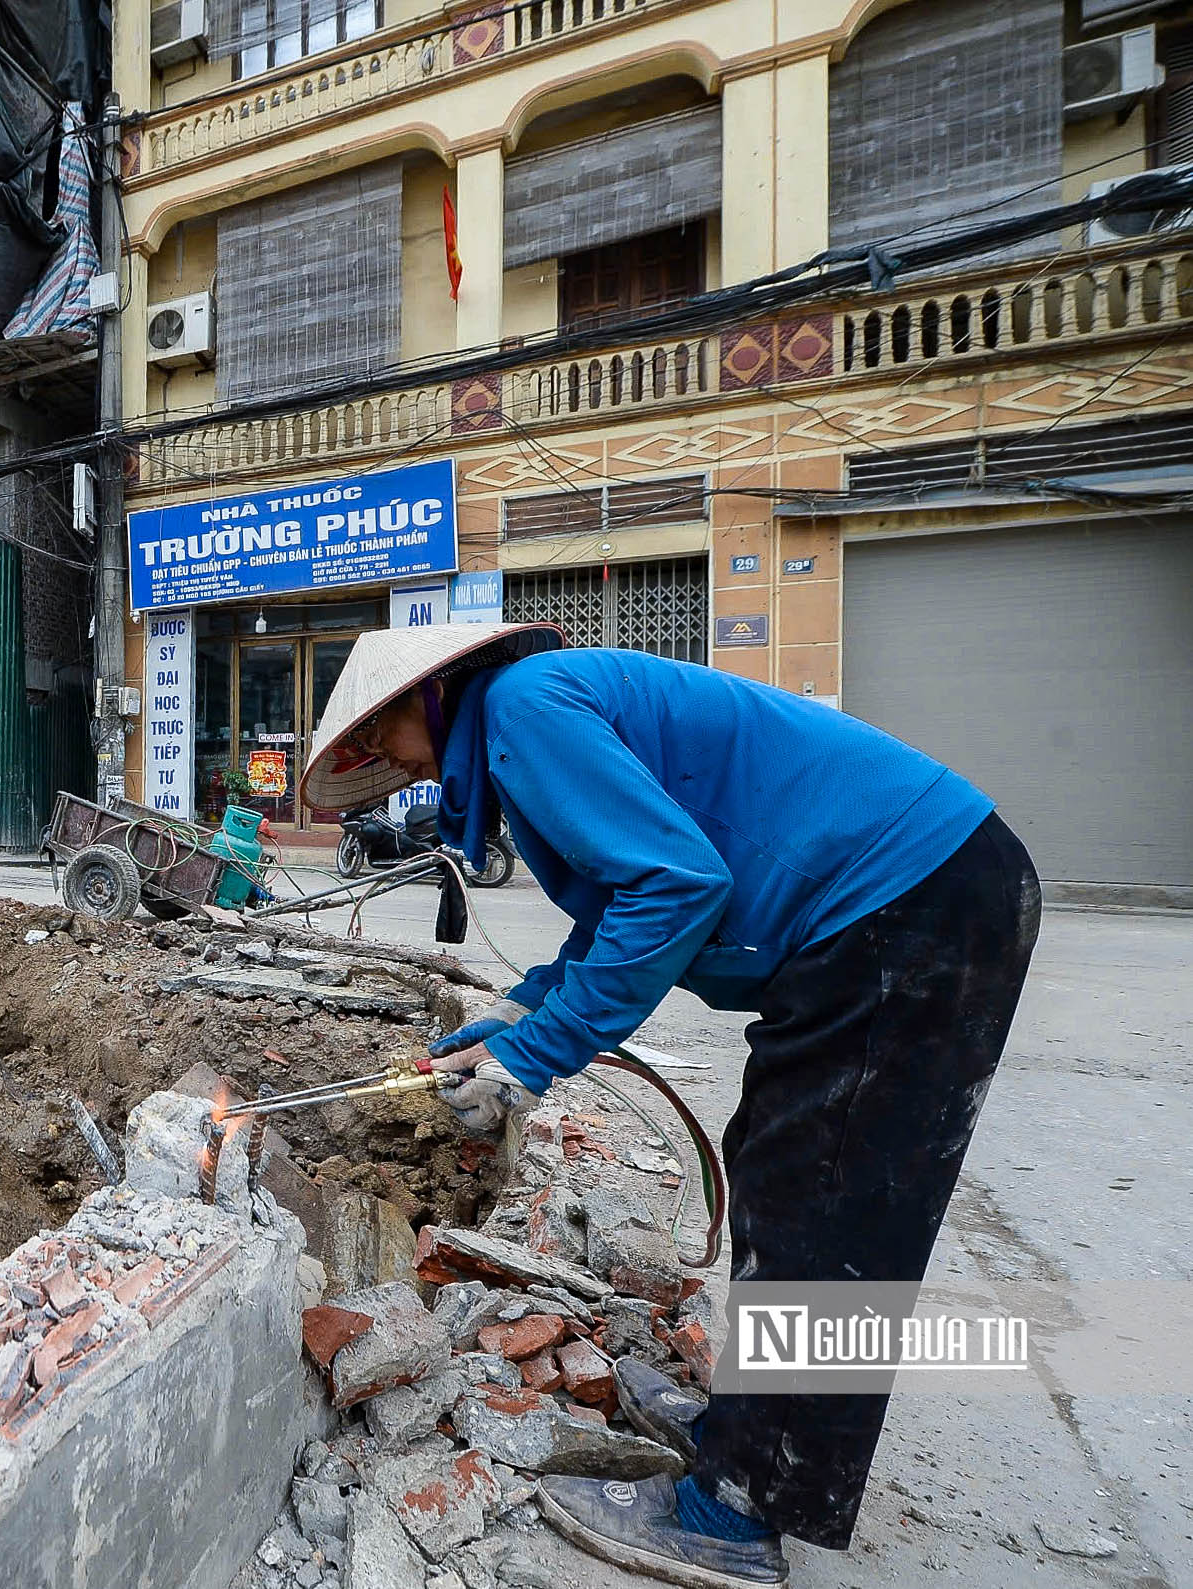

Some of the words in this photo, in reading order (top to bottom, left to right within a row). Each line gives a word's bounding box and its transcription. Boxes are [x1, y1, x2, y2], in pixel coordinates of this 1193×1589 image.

[201, 502, 259, 522] NHÀ
[266, 485, 363, 513] THUỐC
[138, 520, 301, 566] TRƯỜNG
[316, 498, 443, 541] PHÚC
[151, 566, 168, 582] ĐẠT
[169, 564, 189, 578] TIÊU
[222, 558, 241, 571] GPP
[249, 550, 287, 567] CHUYÊN
[288, 547, 309, 562] BÁN
[311, 543, 323, 559] LẺ
[324, 538, 358, 557] THUỐC
[359, 535, 394, 553] THÀNH
[735, 557, 755, 571] 29
[455, 581, 471, 606] NHÀ
[473, 576, 498, 604] THUỐC
[408, 602, 433, 627] AN
[159, 643, 176, 661] SỸ
[157, 670, 179, 688] ĐẠI
[154, 695, 180, 713] HỌC
[151, 719, 184, 738] TRỰC
[285, 733, 294, 741] IN
[153, 740, 181, 760] TIẾP
[158, 768, 175, 785] TƯ
[154, 789, 180, 810] VẤN
